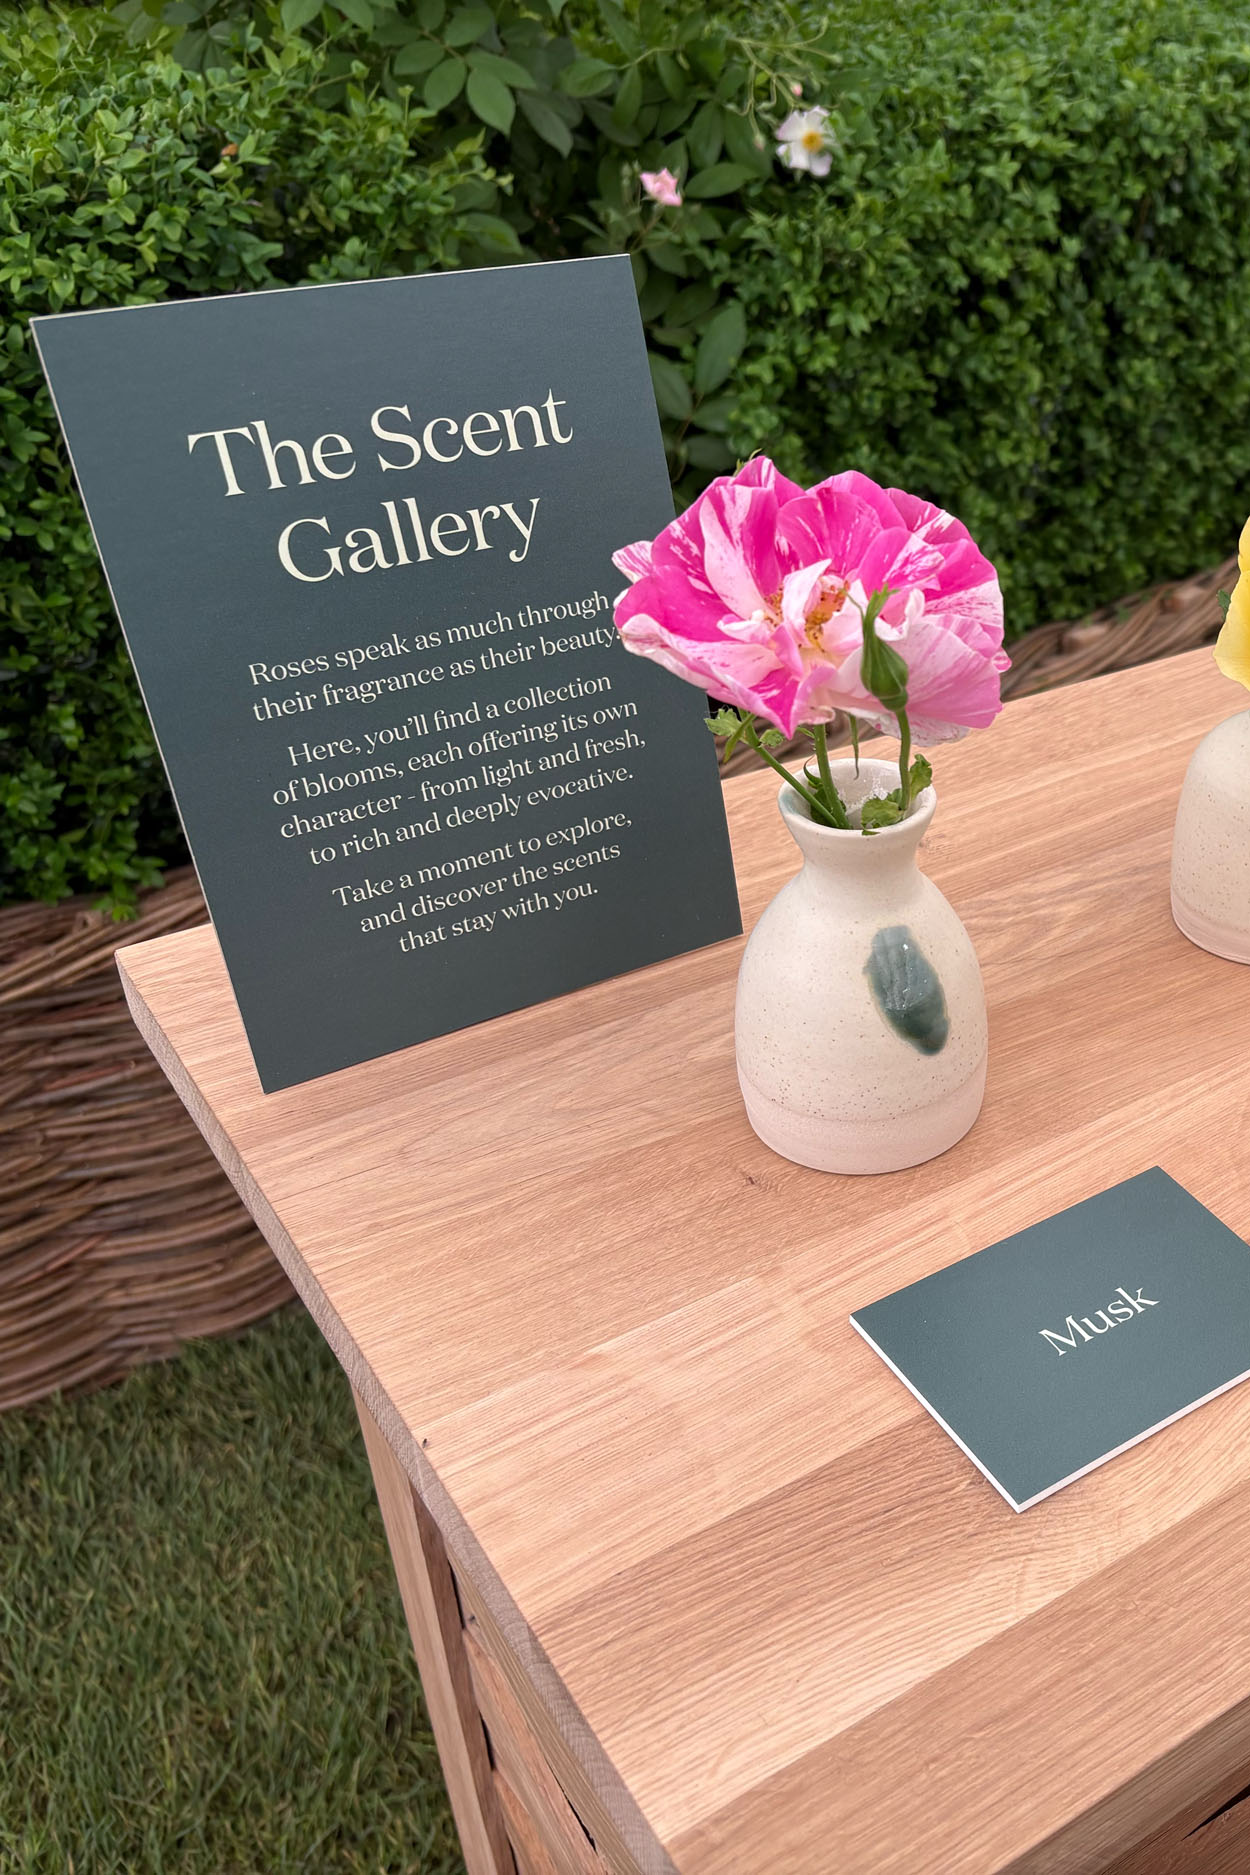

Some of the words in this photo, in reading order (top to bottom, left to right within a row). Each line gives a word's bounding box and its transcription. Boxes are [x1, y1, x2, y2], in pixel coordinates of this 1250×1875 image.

[187, 419, 357, 497] The
[370, 387, 574, 474] Scent
[278, 498, 541, 583] Gallery
[248, 655, 330, 686] Roses
[334, 633, 411, 671] speak
[414, 631, 442, 651] as
[445, 611, 514, 644] much
[517, 590, 610, 628] through
[252, 691, 317, 722] their
[322, 666, 445, 707] fragrance
[449, 659, 476, 678] as
[479, 642, 536, 671] their
[538, 625, 621, 658] beauty.
[272, 779, 299, 805] of
[300, 762, 404, 798] blooms,
[407, 741, 464, 772] each
[468, 721, 559, 756] offering
[560, 714, 589, 733] its
[592, 702, 638, 725] own
[287, 738, 361, 767] Here,
[433, 701, 481, 732] find
[485, 703, 501, 719] a
[504, 676, 612, 714] collection
[280, 794, 402, 839] character
[420, 775, 479, 802] from
[480, 758, 534, 788] light
[538, 742, 581, 771] and
[585, 728, 646, 759] fresh,
[309, 846, 336, 865] to
[341, 827, 391, 857] rich
[395, 811, 442, 842] and
[445, 792, 521, 828] deeply
[526, 767, 634, 806] evocative.
[331, 878, 394, 907] Take
[399, 874, 415, 889] a
[417, 842, 515, 884] moment
[518, 837, 542, 855] to
[545, 813, 632, 847] explore,
[360, 901, 407, 933] and
[411, 877, 508, 917] discover
[511, 865, 549, 887] the
[552, 844, 621, 876] scents
[399, 925, 448, 953] that
[451, 911, 497, 937] stay
[500, 892, 550, 920] with
[552, 882, 598, 911] you.
[1037, 1287, 1161, 1357] Musk
